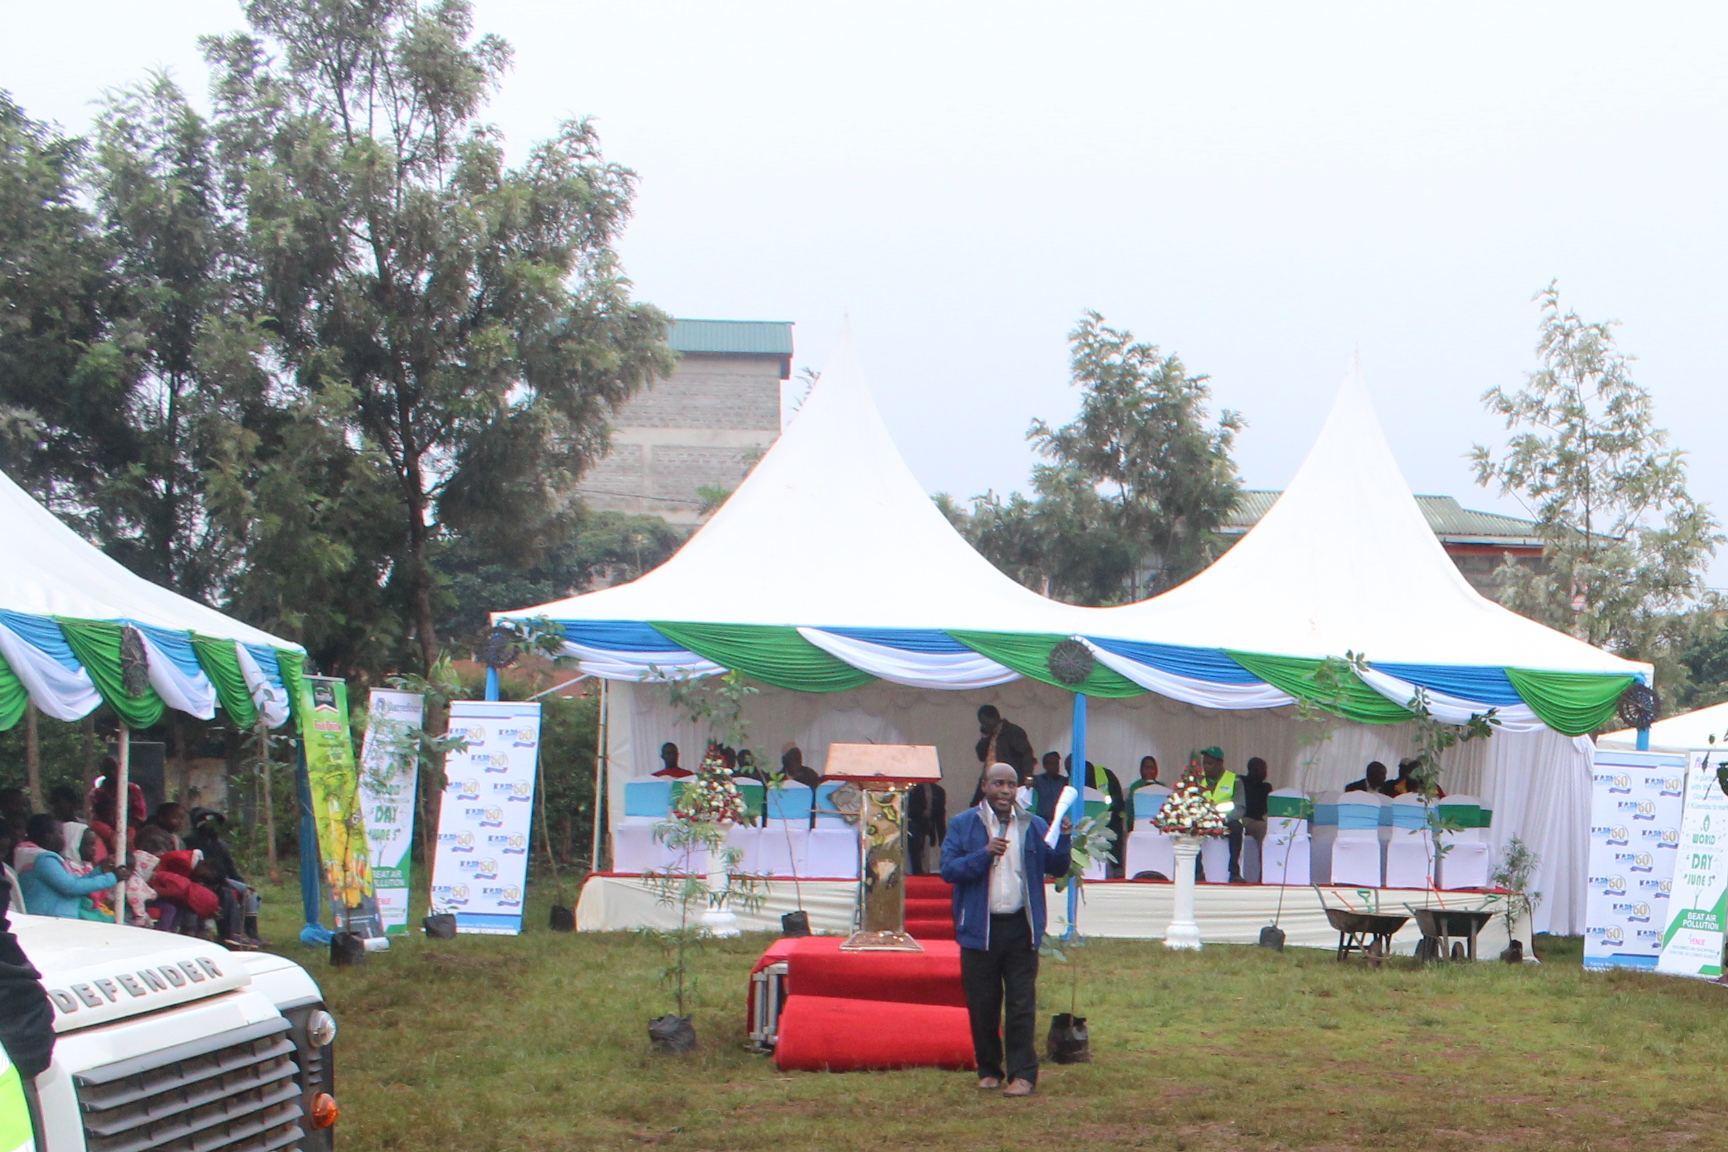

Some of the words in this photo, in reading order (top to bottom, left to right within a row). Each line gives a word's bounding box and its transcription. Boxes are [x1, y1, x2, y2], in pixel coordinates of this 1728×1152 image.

[1614, 775, 1628, 787] 60
[1664, 778, 1679, 790] 60
[374, 805, 398, 823] DAY
[1638, 802, 1653, 814] 60
[1611, 827, 1626, 839] 60
[1662, 830, 1676, 843] 60
[1692, 834, 1715, 845] WORLD
[1635, 854, 1650, 866] 60
[1692, 853, 1713, 870] DAY
[1609, 877, 1623, 889] 60
[1687, 874, 1706, 886] JUNE
[1633, 904, 1648, 916] 60
[1687, 912, 1705, 920] BEAT
[1682, 919, 1720, 930] POLLUTION
[1606, 928, 1621, 939] 60
[1690, 937, 1706, 945] VENUE
[48, 956, 224, 1014] DEFENDER
